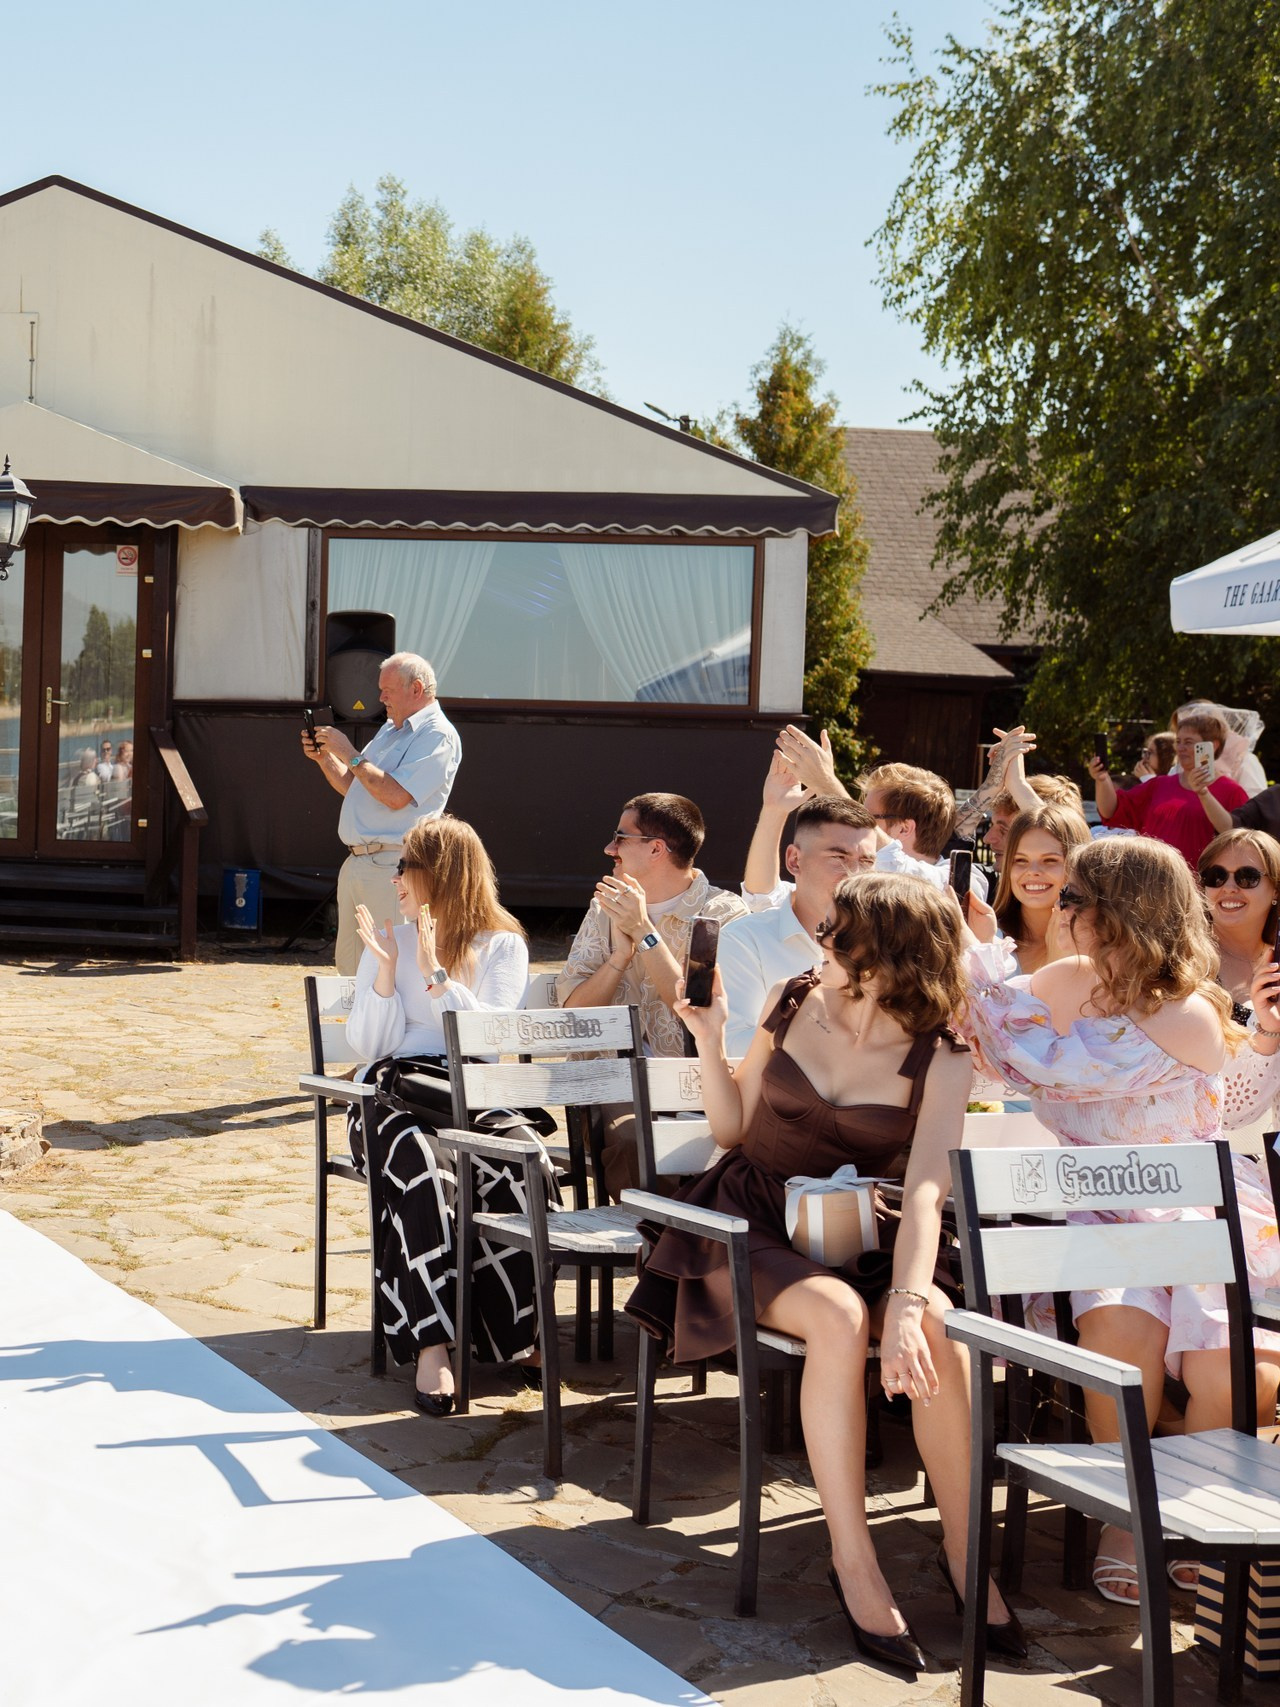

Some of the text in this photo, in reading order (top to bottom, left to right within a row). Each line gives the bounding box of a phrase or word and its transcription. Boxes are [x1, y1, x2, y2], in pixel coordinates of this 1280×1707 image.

[1224, 584, 1248, 608] THE
[517, 1012, 603, 1045] Gaarden
[1056, 1151, 1182, 1205] Gaarden
